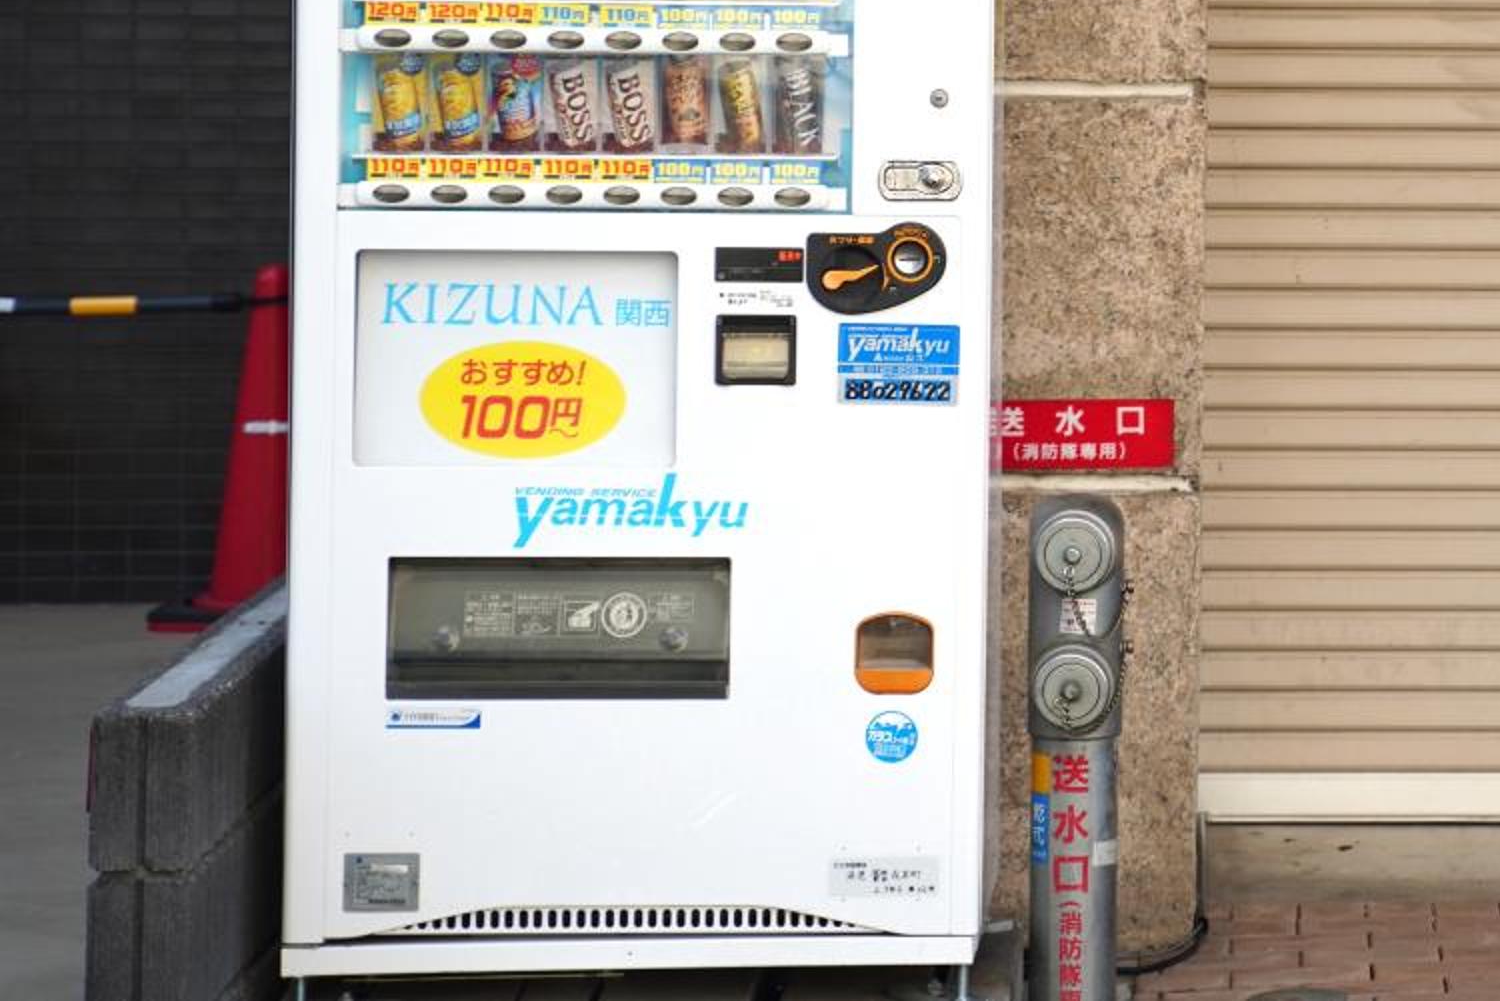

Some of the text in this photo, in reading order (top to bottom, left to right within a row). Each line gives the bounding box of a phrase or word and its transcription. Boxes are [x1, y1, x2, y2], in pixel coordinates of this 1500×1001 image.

[368, 1, 417, 17] 120円
[430, 3, 479, 18] 120円
[487, 2, 533, 18] 110円
[607, 8, 649, 21] 110円
[562, 73, 593, 142] BOSS
[618, 73, 649, 142] BOSS
[370, 158, 419, 173] 110円
[429, 159, 476, 173] 110円
[484, 159, 533, 173] 110円
[545, 160, 592, 174] 110円
[603, 160, 651, 175] 110円
[382, 282, 673, 327] KIZUNA 関西
[847, 327, 951, 361] yamakyu
[460, 359, 587, 386] おすすめ!
[515, 487, 657, 497] VENDING SERVICE
[513, 473, 748, 548] yamakyu
[1053, 754, 1089, 894] 送水口
